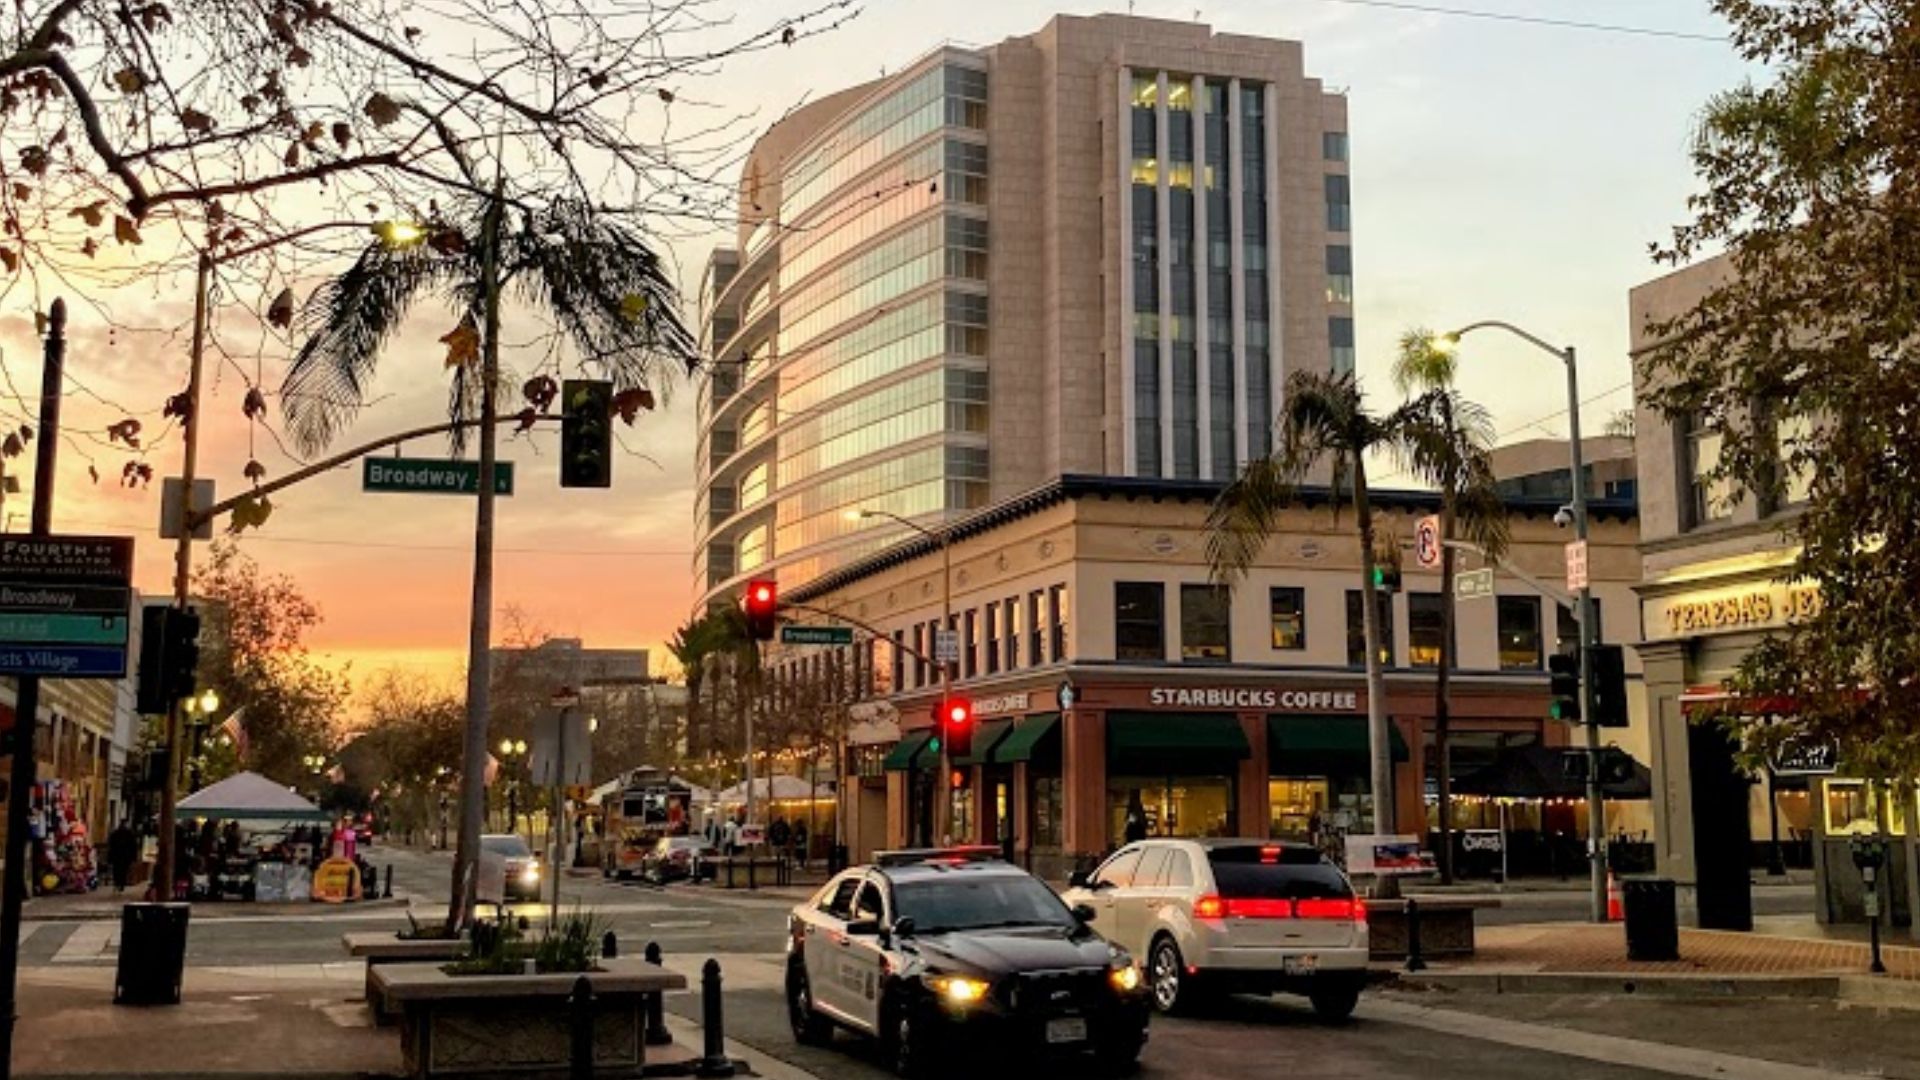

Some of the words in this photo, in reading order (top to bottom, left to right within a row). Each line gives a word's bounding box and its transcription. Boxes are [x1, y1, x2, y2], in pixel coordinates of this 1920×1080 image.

[369, 465, 468, 489] Broadway
[4, 541, 88, 556] FOURTH
[2, 586, 76, 609] Broadway
[1666, 592, 1773, 632] TERESA'S
[27, 651, 79, 672] Village
[1150, 688, 1276, 707] STARBUCKS
[1281, 690, 1357, 709] COFFEE
